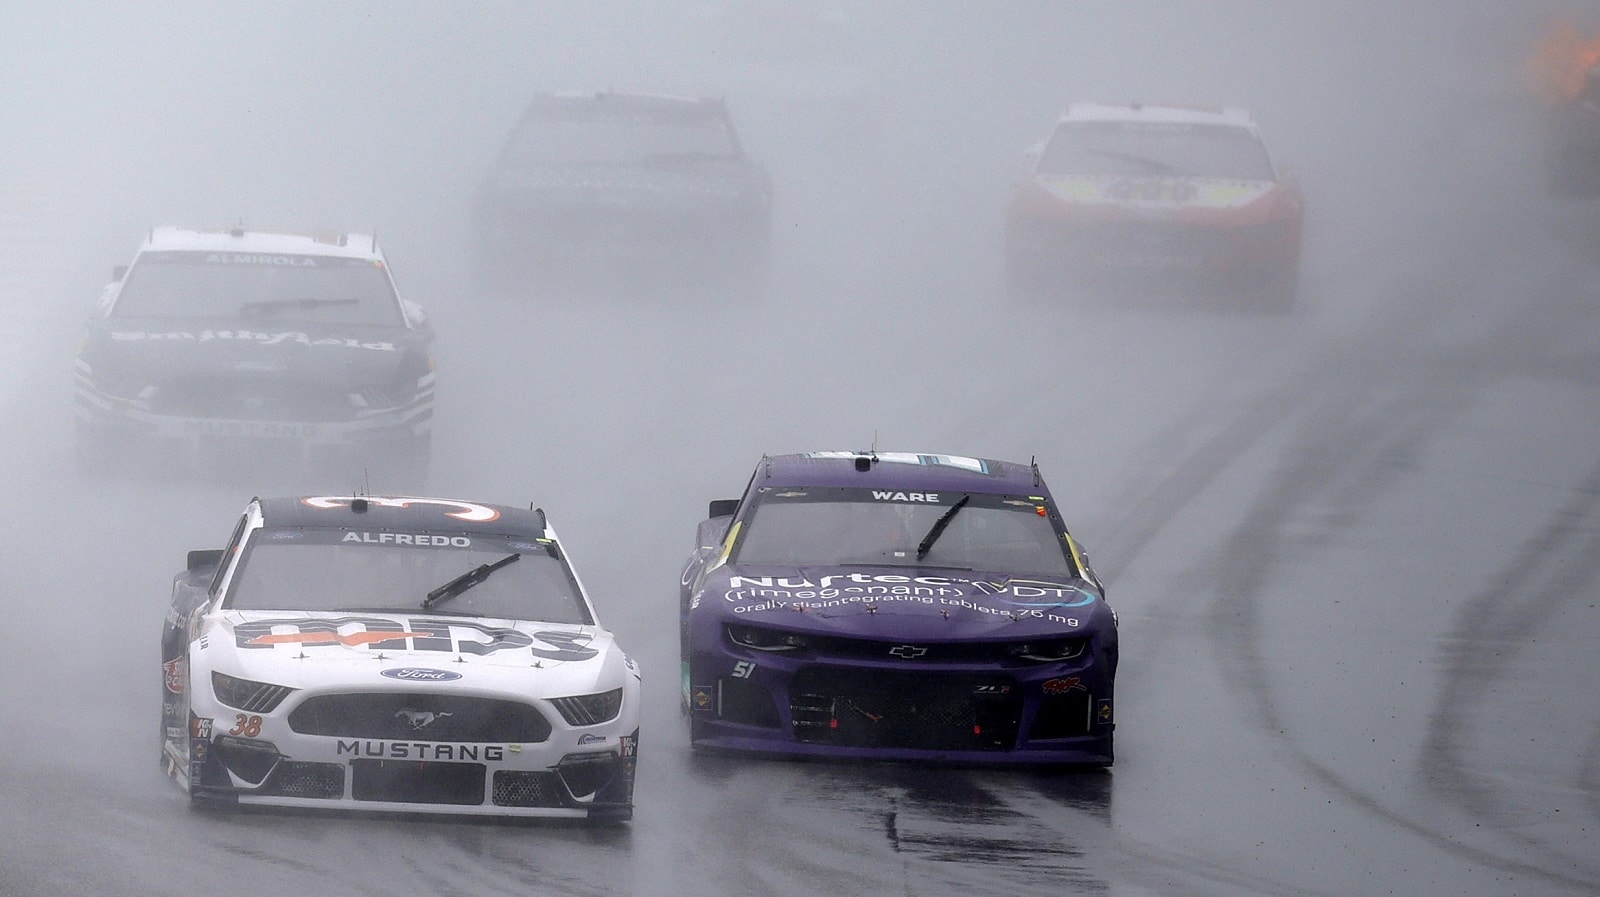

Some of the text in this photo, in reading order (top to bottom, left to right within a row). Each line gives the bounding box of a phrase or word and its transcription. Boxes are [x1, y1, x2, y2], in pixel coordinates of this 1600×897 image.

[206, 253, 317, 268] ALMIROLA
[871, 491, 940, 503] WARE
[341, 531, 472, 548] ALFREDO
[734, 595, 1080, 627] orally disintegrating tablets 75 mg
[731, 660, 757, 679] 51
[228, 714, 263, 738] 38
[336, 740, 503, 761] MUSTANG
